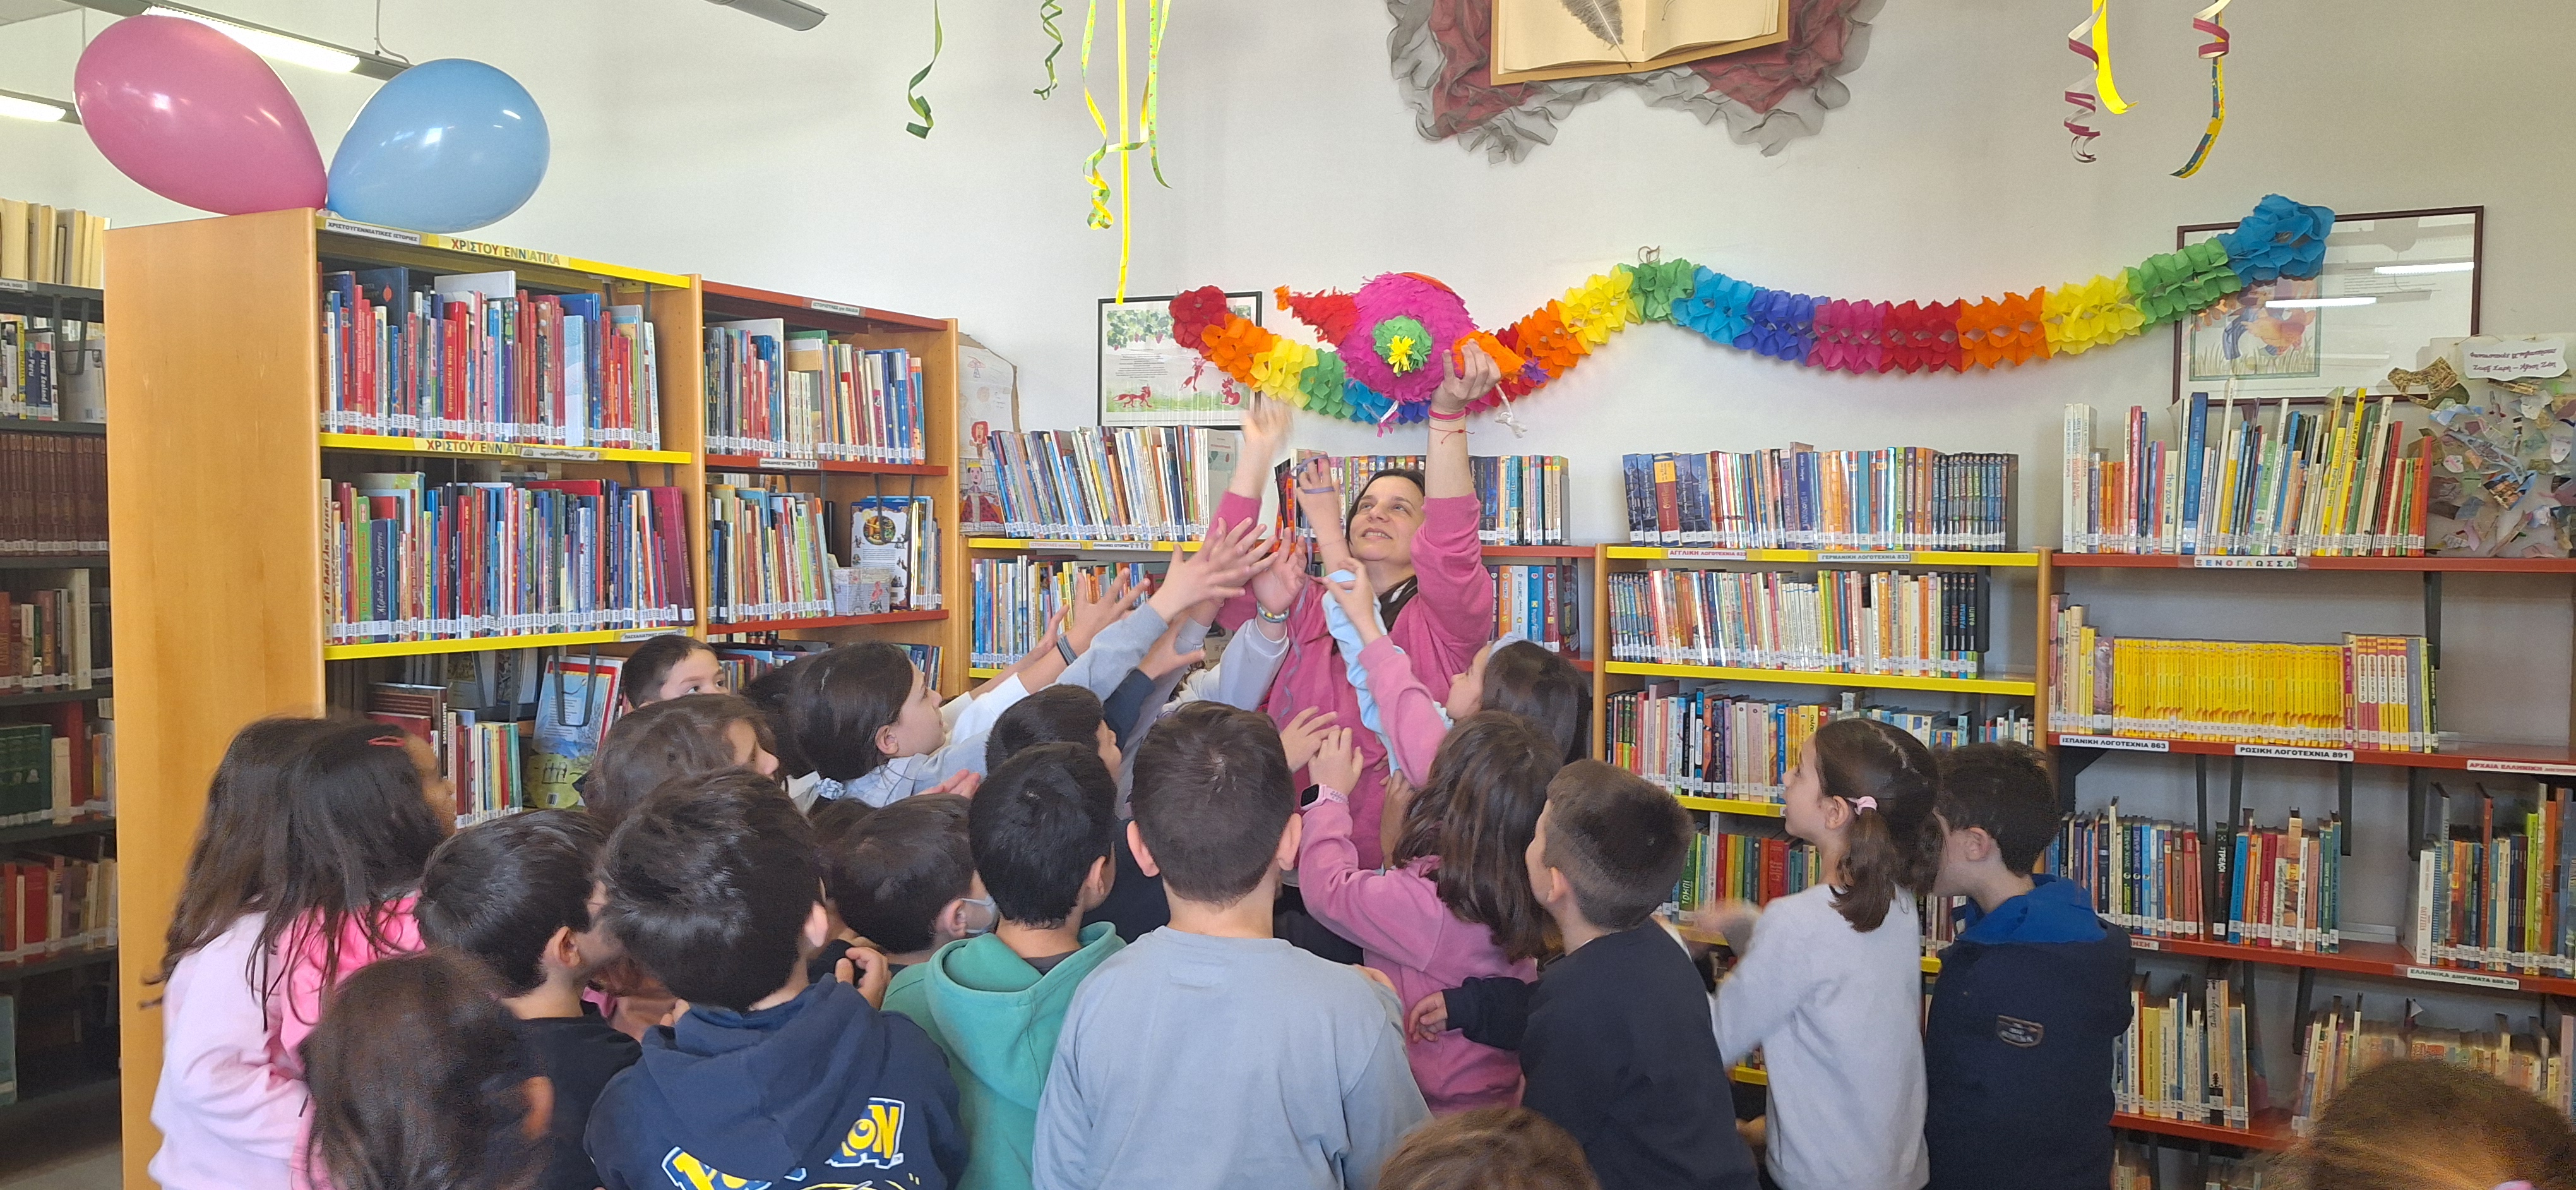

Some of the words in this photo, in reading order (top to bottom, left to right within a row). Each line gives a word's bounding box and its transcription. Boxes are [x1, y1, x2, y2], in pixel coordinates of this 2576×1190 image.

[328, 222, 392, 237] ΧΡΙΣΤΟΥΓΕΝΝΙΑΤΙΚΕΣ
[393, 233, 418, 242] ΙΣΤΟΡΙΕΣ
[451, 239, 560, 265] ΧΡΙΣΤΟΥΓΕΝΝΙΑΤΙΚΑ
[40, 376, 49, 402] Zealand
[2166, 473, 2174, 487] the
[2274, 749, 2330, 757] ΛΟΓΟΤΕΧΝΙΑ
[2411, 969, 2450, 978] ΕΛΛΗΝΙΚΑ
